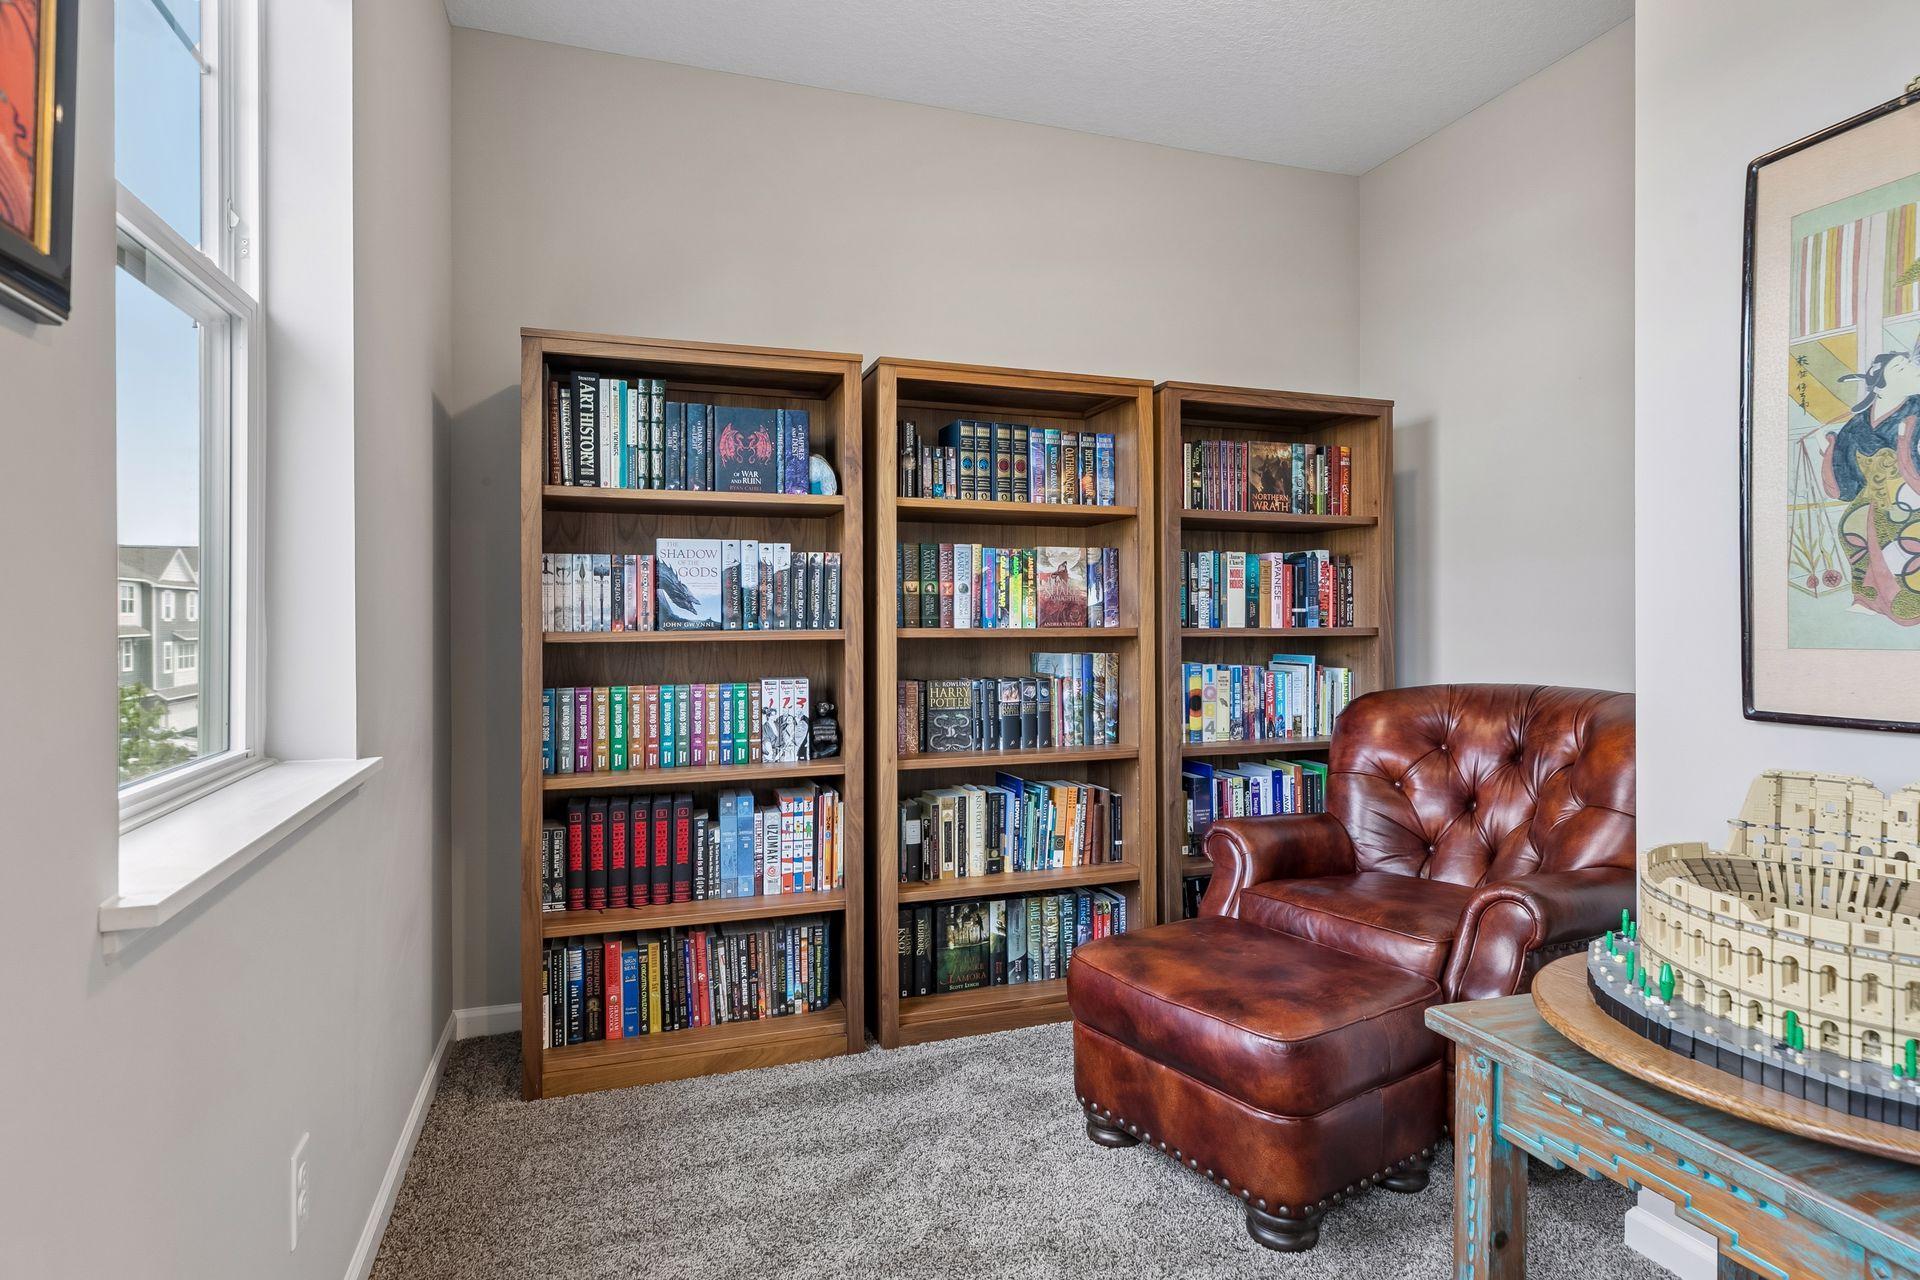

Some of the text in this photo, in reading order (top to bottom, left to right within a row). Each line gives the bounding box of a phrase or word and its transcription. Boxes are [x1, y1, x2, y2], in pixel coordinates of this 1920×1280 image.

[580, 382, 596, 411] ART
[562, 400, 572, 449] NUTCRACKER
[580, 412, 595, 468] HISTORY
[791, 437, 799, 458] DUST
[1065, 448, 1075, 496] OATHBRINGER
[1085, 449, 1094, 476] RHYTHM
[741, 470, 759, 478] WAR
[742, 477, 762, 485] RUIN
[1252, 493, 1289, 501] NORTHERN
[1252, 500, 1289, 512] WRATH
[660, 548, 718, 559] SHADOW
[678, 566, 718, 578] GODS
[1229, 569, 1244, 579] NOBLE
[1274, 556, 1282, 600] JAPANESE
[1229, 579, 1244, 589] HOUSE
[1206, 668, 1213, 682] 1
[782, 696, 793, 709] 2
[796, 697, 807, 709] 3
[930, 687, 970, 698] HARRY
[930, 697, 970, 708] POTTER
[1204, 720, 1216, 735] 4
[975, 796, 983, 839] KEN FOLLETT
[1274, 800, 1282, 814] JAVA
[612, 822, 625, 869] BERSERK
[634, 821, 647, 868] BERSERK
[655, 820, 668, 867] BERSERK
[676, 818, 689, 865] BERSERK
[755, 819, 763, 851] FULLMETAL
[766, 824, 779, 864] UZUMAKI
[569, 824, 582, 871] BERSERK
[590, 824, 604, 871] BERSERK
[1030, 901, 1040, 921] JADE
[1047, 900, 1057, 921] JADE
[1064, 898, 1073, 916] JADE
[916, 919, 925, 956] MIRRORS
[1030, 924, 1040, 942] CITY
[1047, 924, 1057, 943] WAR
[1064, 917, 1073, 943] LEGACY
[898, 928, 906, 956] KNOT
[947, 972, 987, 984] LAMORA
[741, 979, 749, 1006] GENESIS
